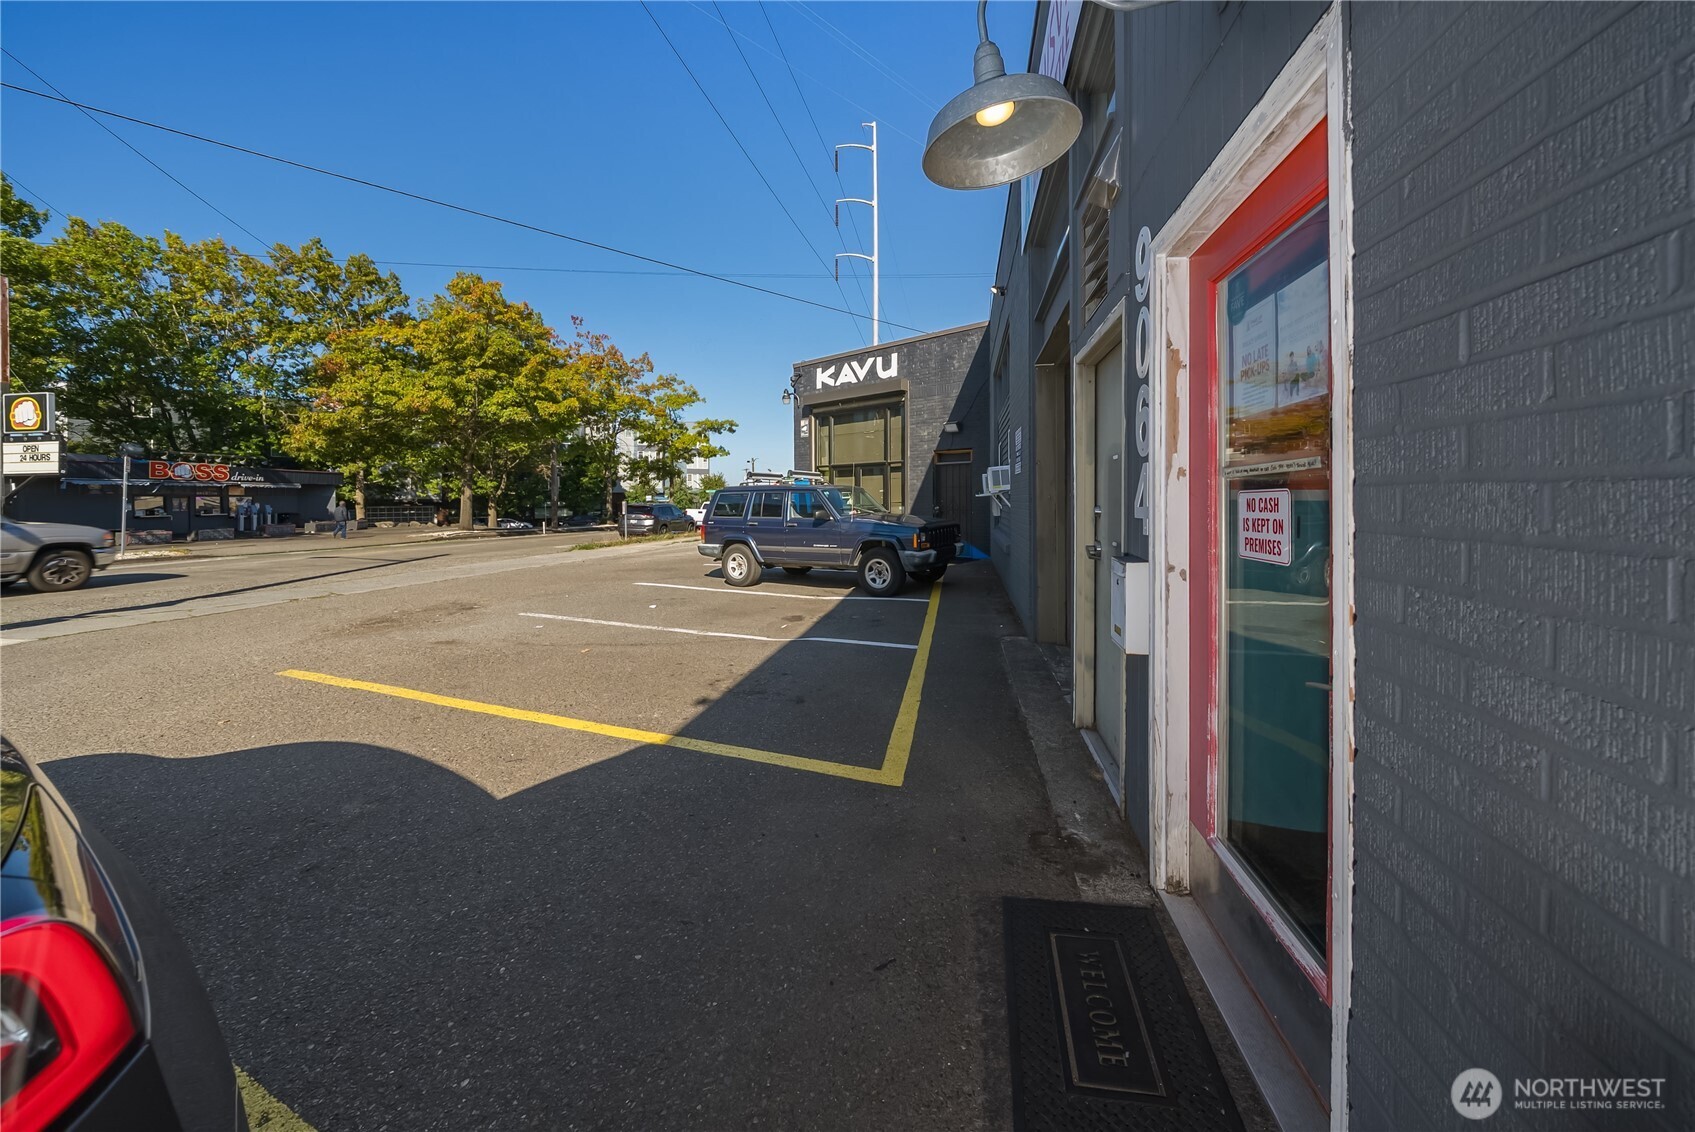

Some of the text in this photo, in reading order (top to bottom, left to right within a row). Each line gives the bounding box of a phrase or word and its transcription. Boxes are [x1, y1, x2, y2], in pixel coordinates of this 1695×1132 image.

[1240, 343, 1269, 367] NO LATE
[816, 352, 898, 390] KAVU
[1134, 226, 1151, 536] 9064
[1239, 357, 1270, 383] PICK-UPS
[19, 453, 51, 462] 24 HOURS
[22, 444, 39, 453] OPEN
[148, 460, 230, 481] BOSS
[230, 471, 265, 482] drive-in
[1246, 497, 1279, 513] NO CASH
[1243, 517, 1284, 535] IS KEPT ON
[1245, 537, 1282, 557] PREMISES
[1078, 952, 1128, 1068] WELCOME
